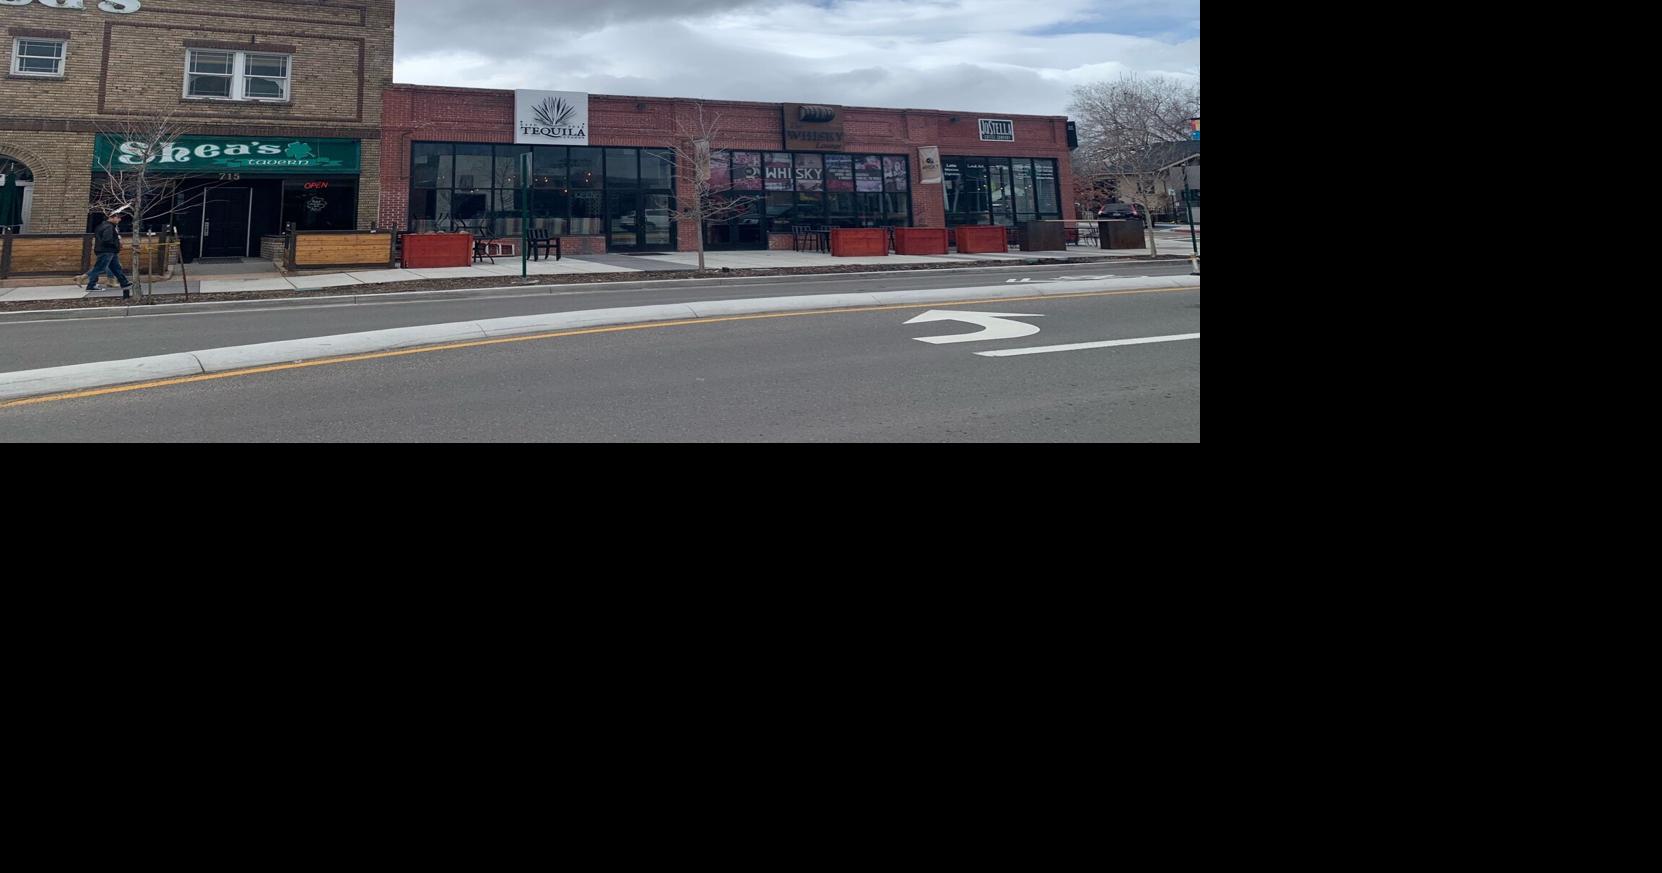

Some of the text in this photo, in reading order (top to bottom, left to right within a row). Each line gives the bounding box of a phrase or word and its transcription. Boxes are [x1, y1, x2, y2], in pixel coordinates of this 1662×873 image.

[520, 126, 586, 138] TEQUILA
[118, 141, 281, 165] Shea's
[219, 172, 240, 181] 715
[765, 166, 823, 180] WHISKY
[303, 181, 329, 189] OPEN
